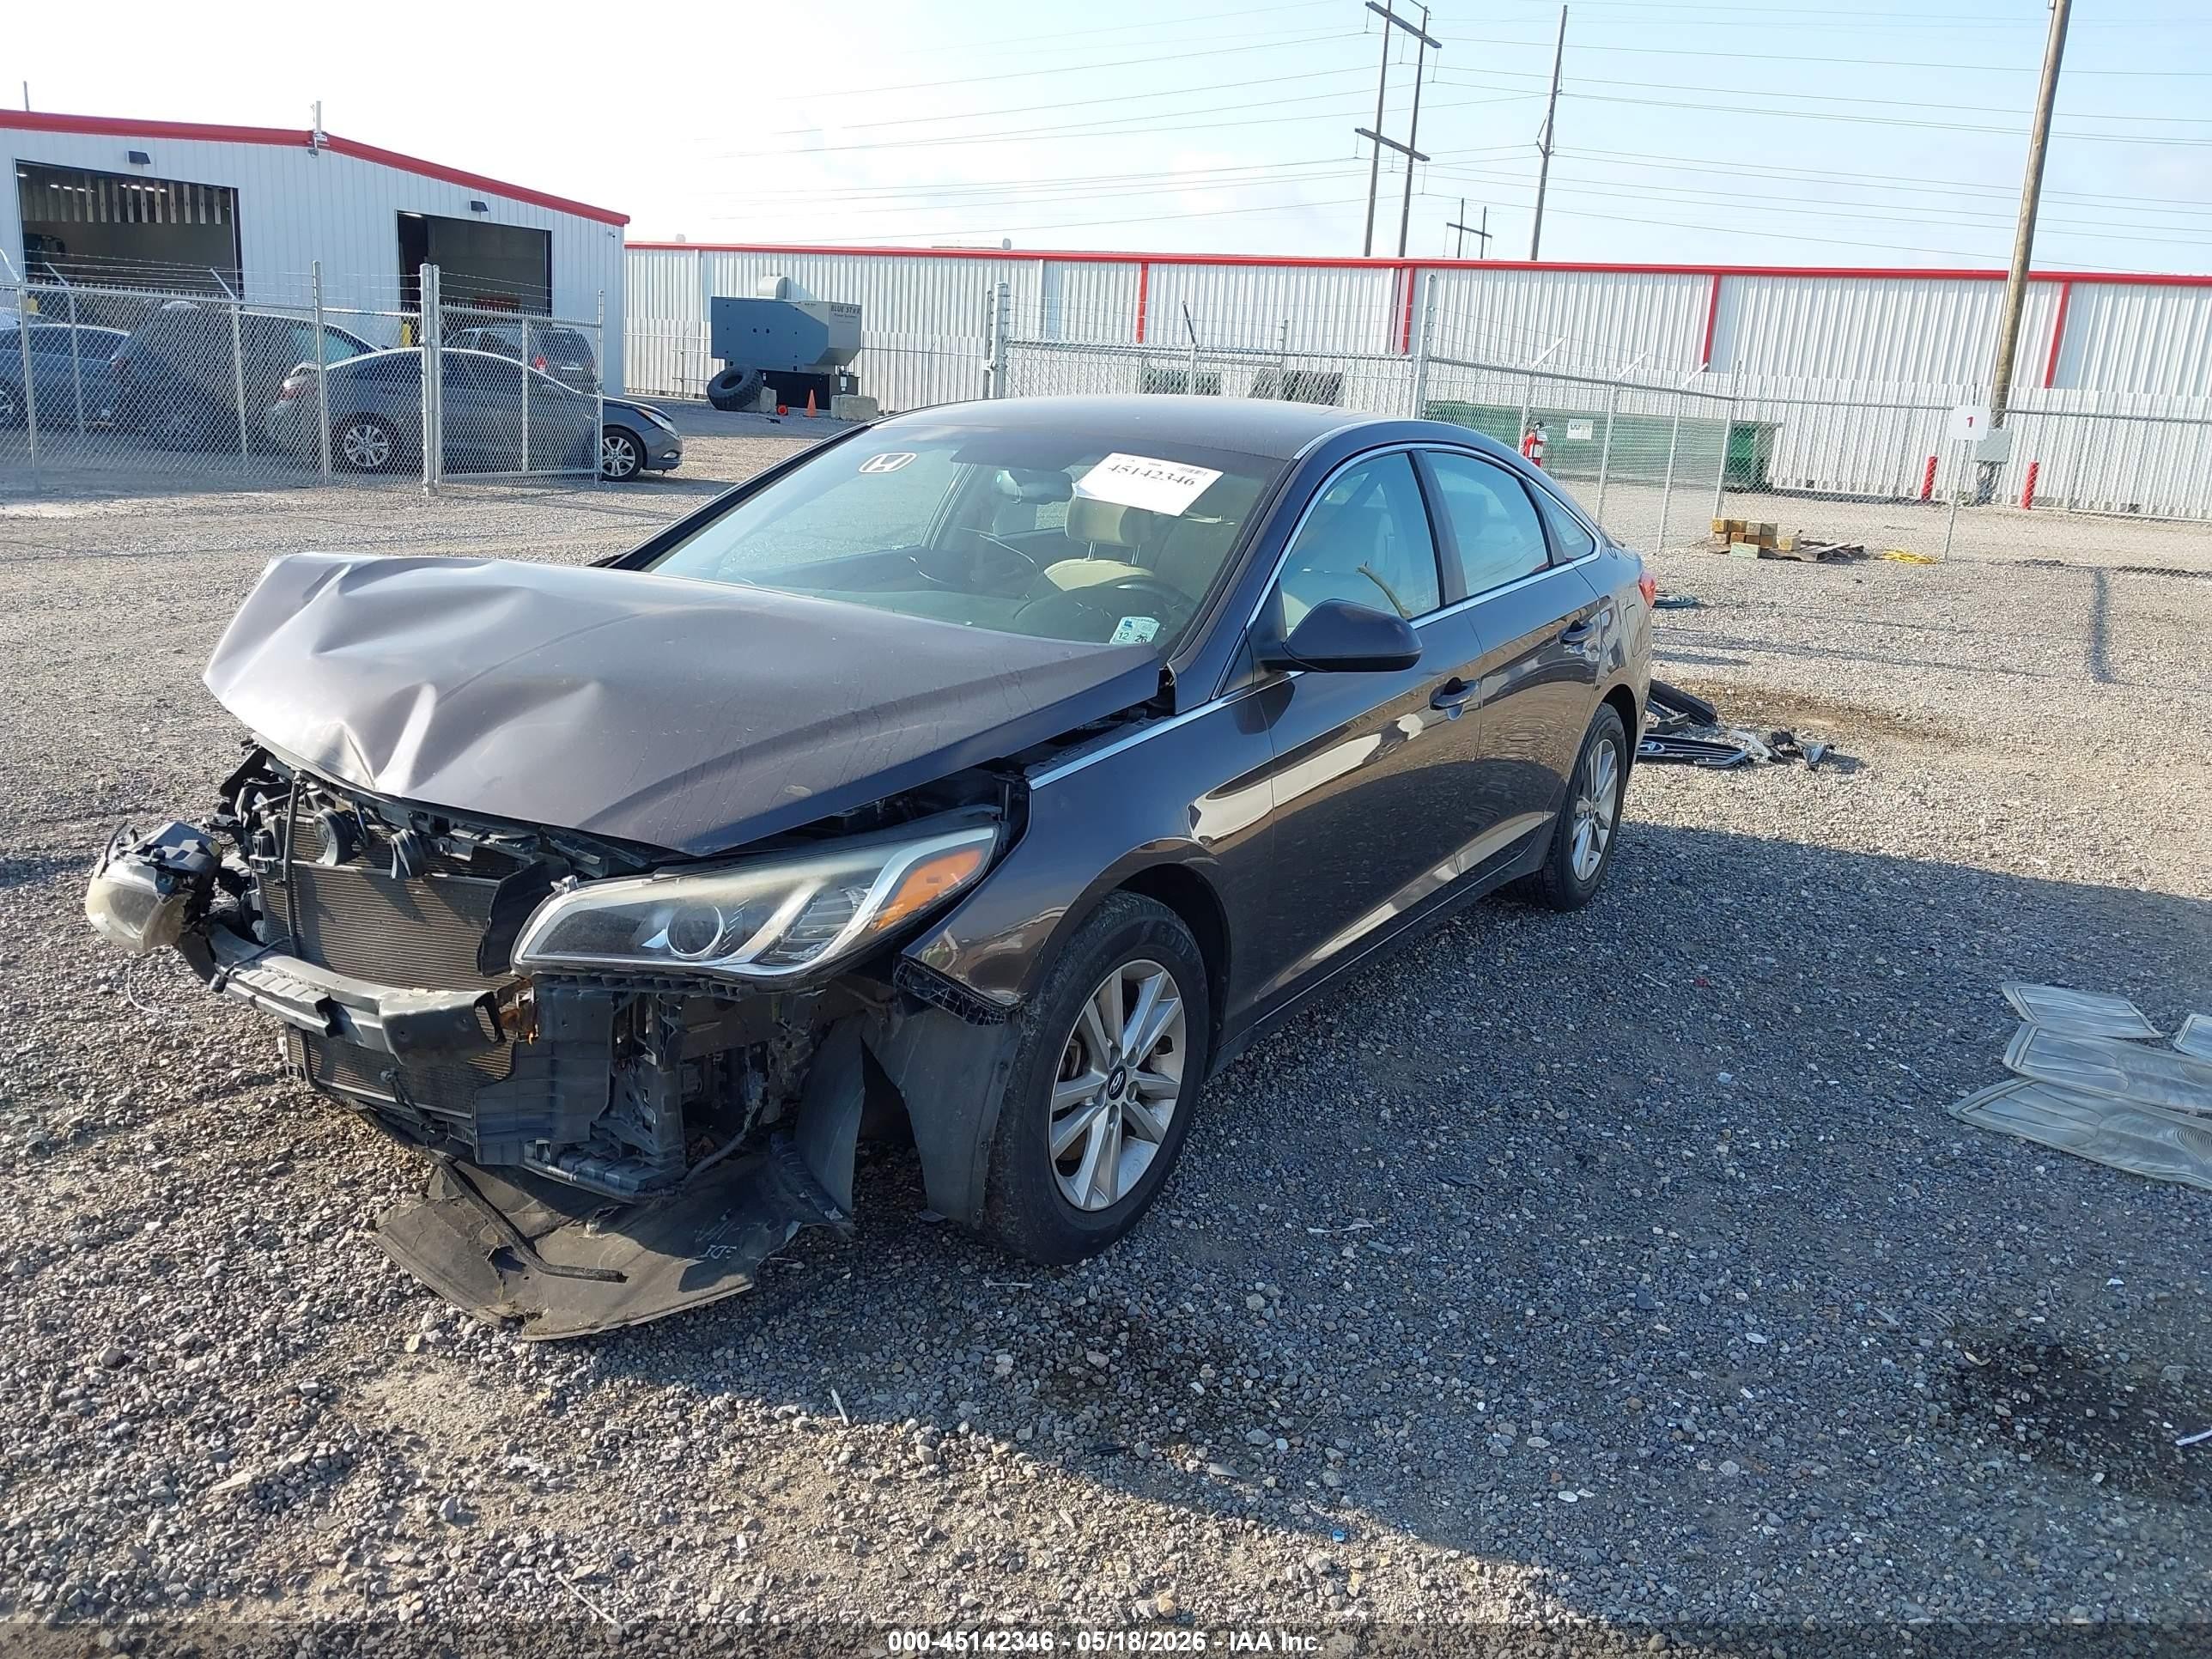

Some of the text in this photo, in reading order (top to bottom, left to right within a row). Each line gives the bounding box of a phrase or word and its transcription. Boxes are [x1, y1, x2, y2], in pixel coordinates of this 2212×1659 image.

[831, 304, 844, 313] BLUE
[1966, 416, 1974, 428] 1
[1108, 465, 1195, 486] 45142346
